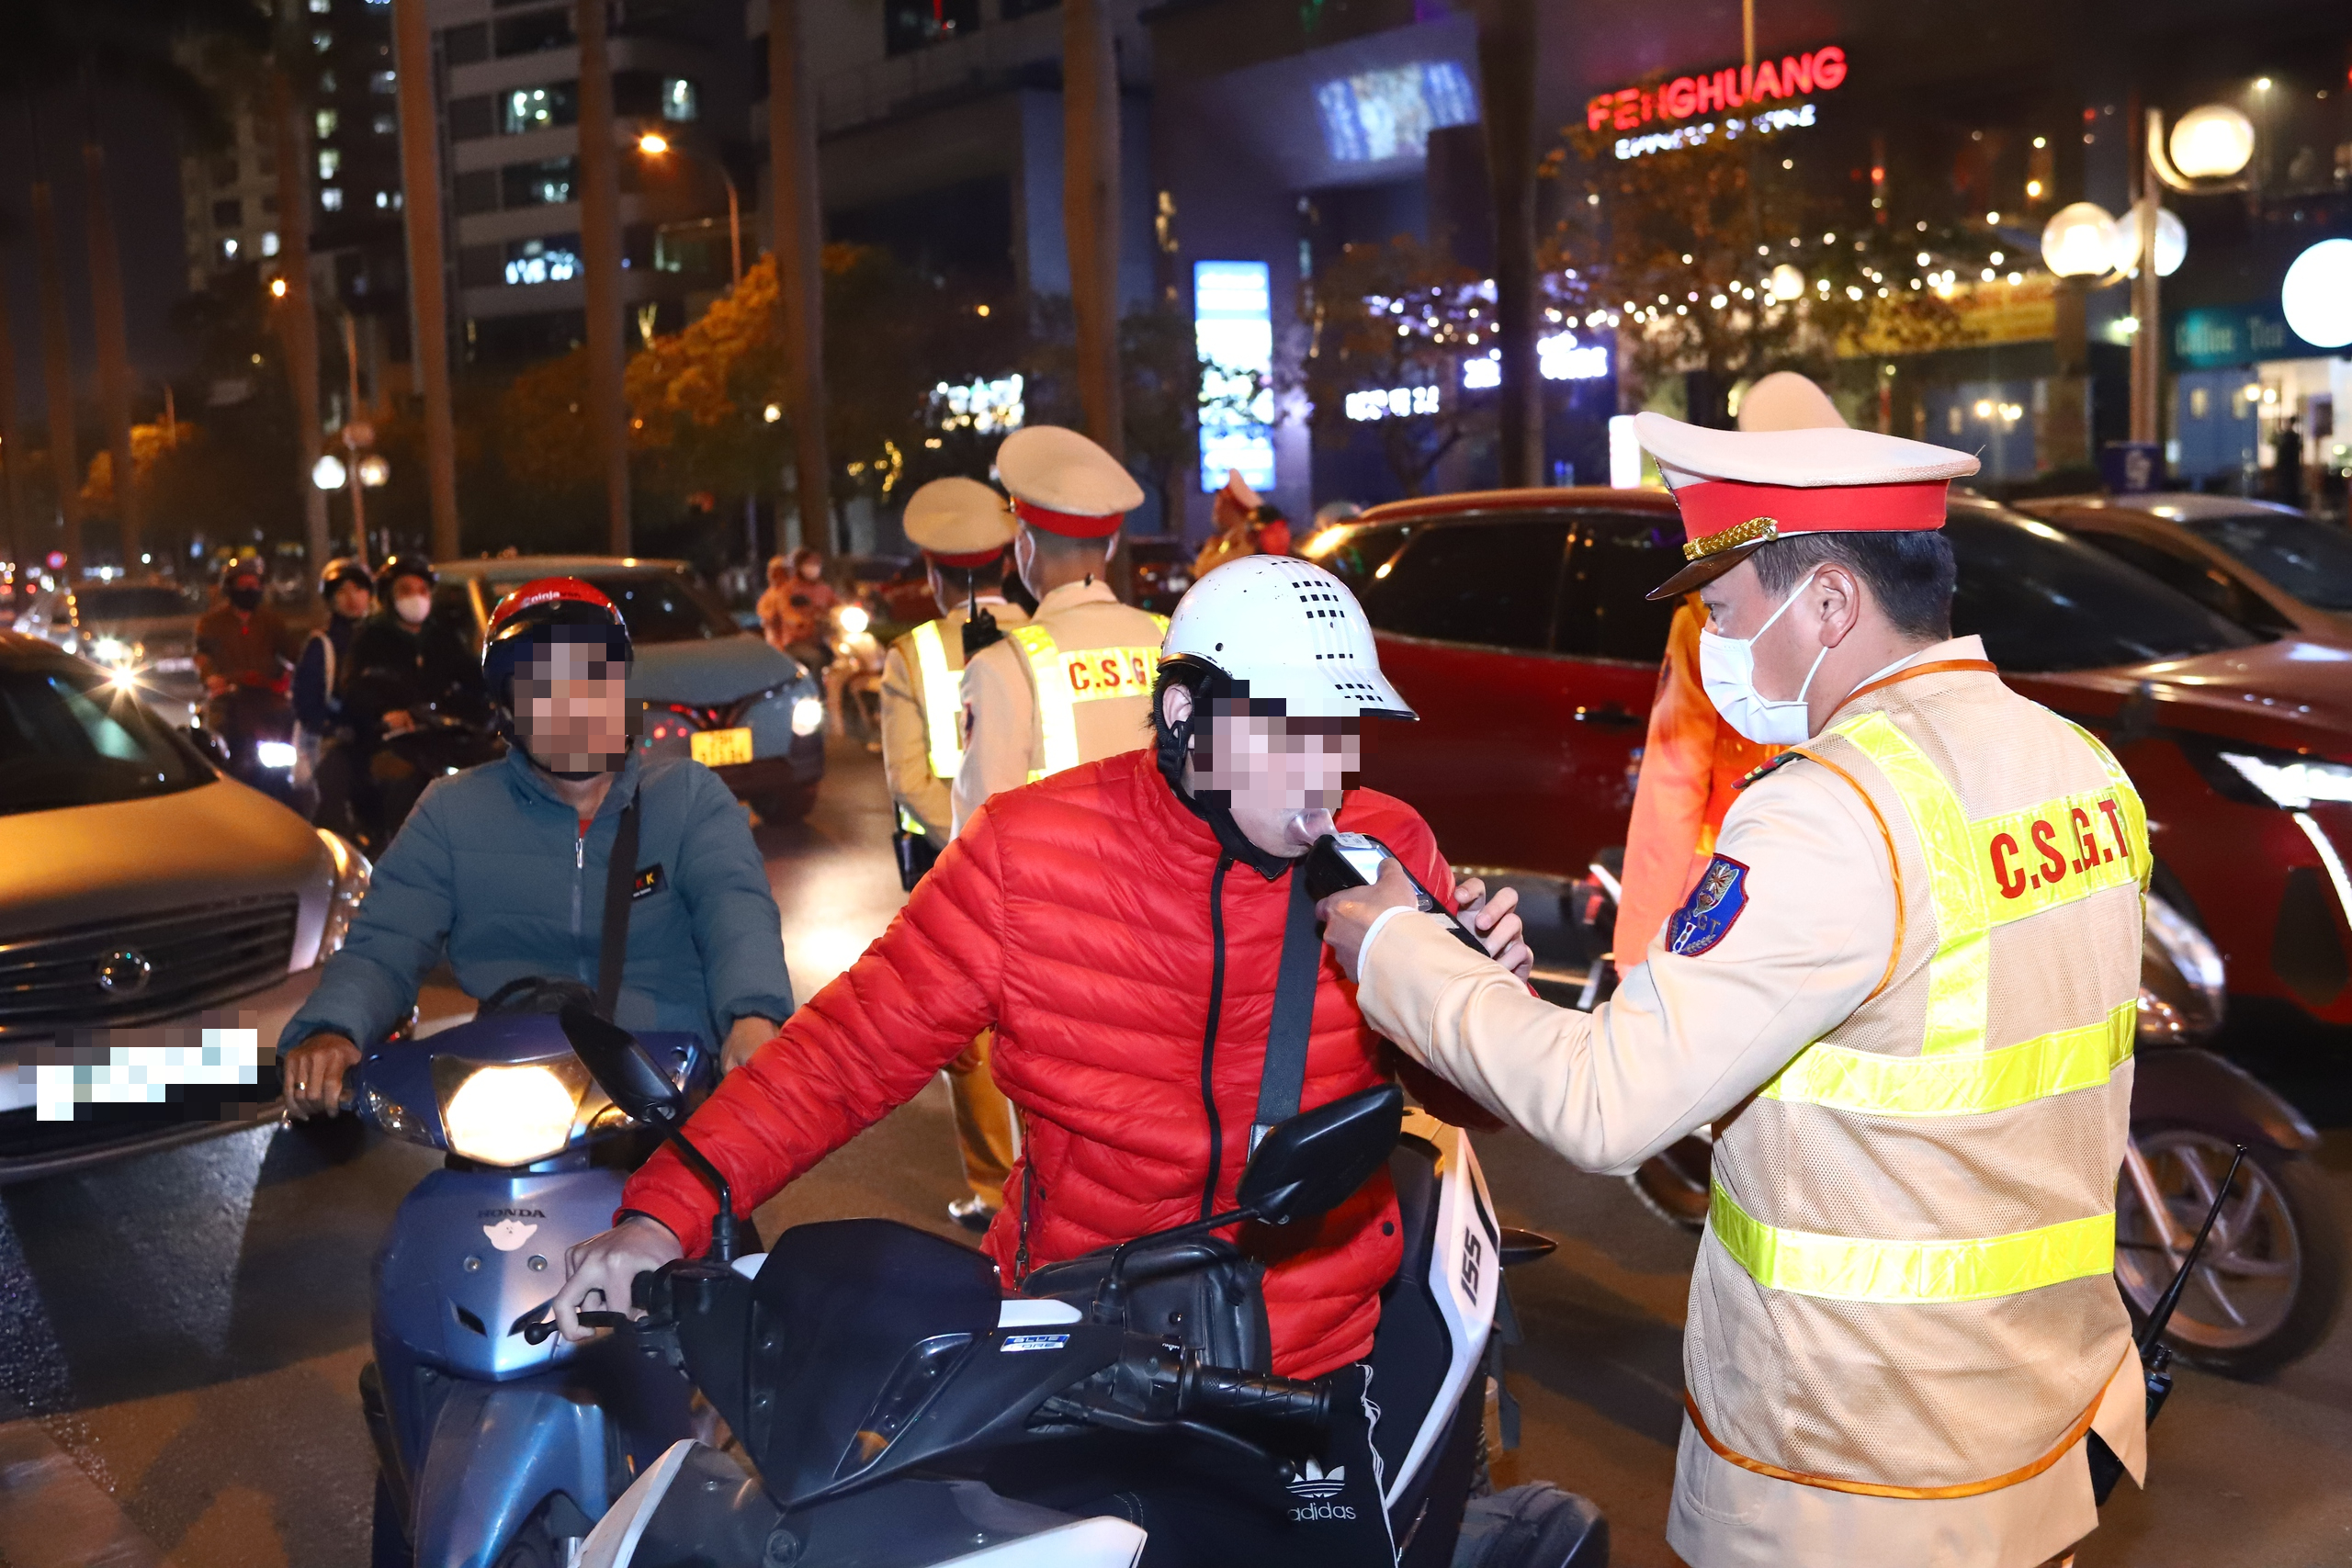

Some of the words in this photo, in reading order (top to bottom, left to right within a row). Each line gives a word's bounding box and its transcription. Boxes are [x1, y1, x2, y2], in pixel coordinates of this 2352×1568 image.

[1990, 798, 2129, 899] C.S.G.T
[477, 1207, 547, 1219] HONDA
[1460, 1225, 1482, 1308] 155
[1287, 1501, 1357, 1522] adidas
